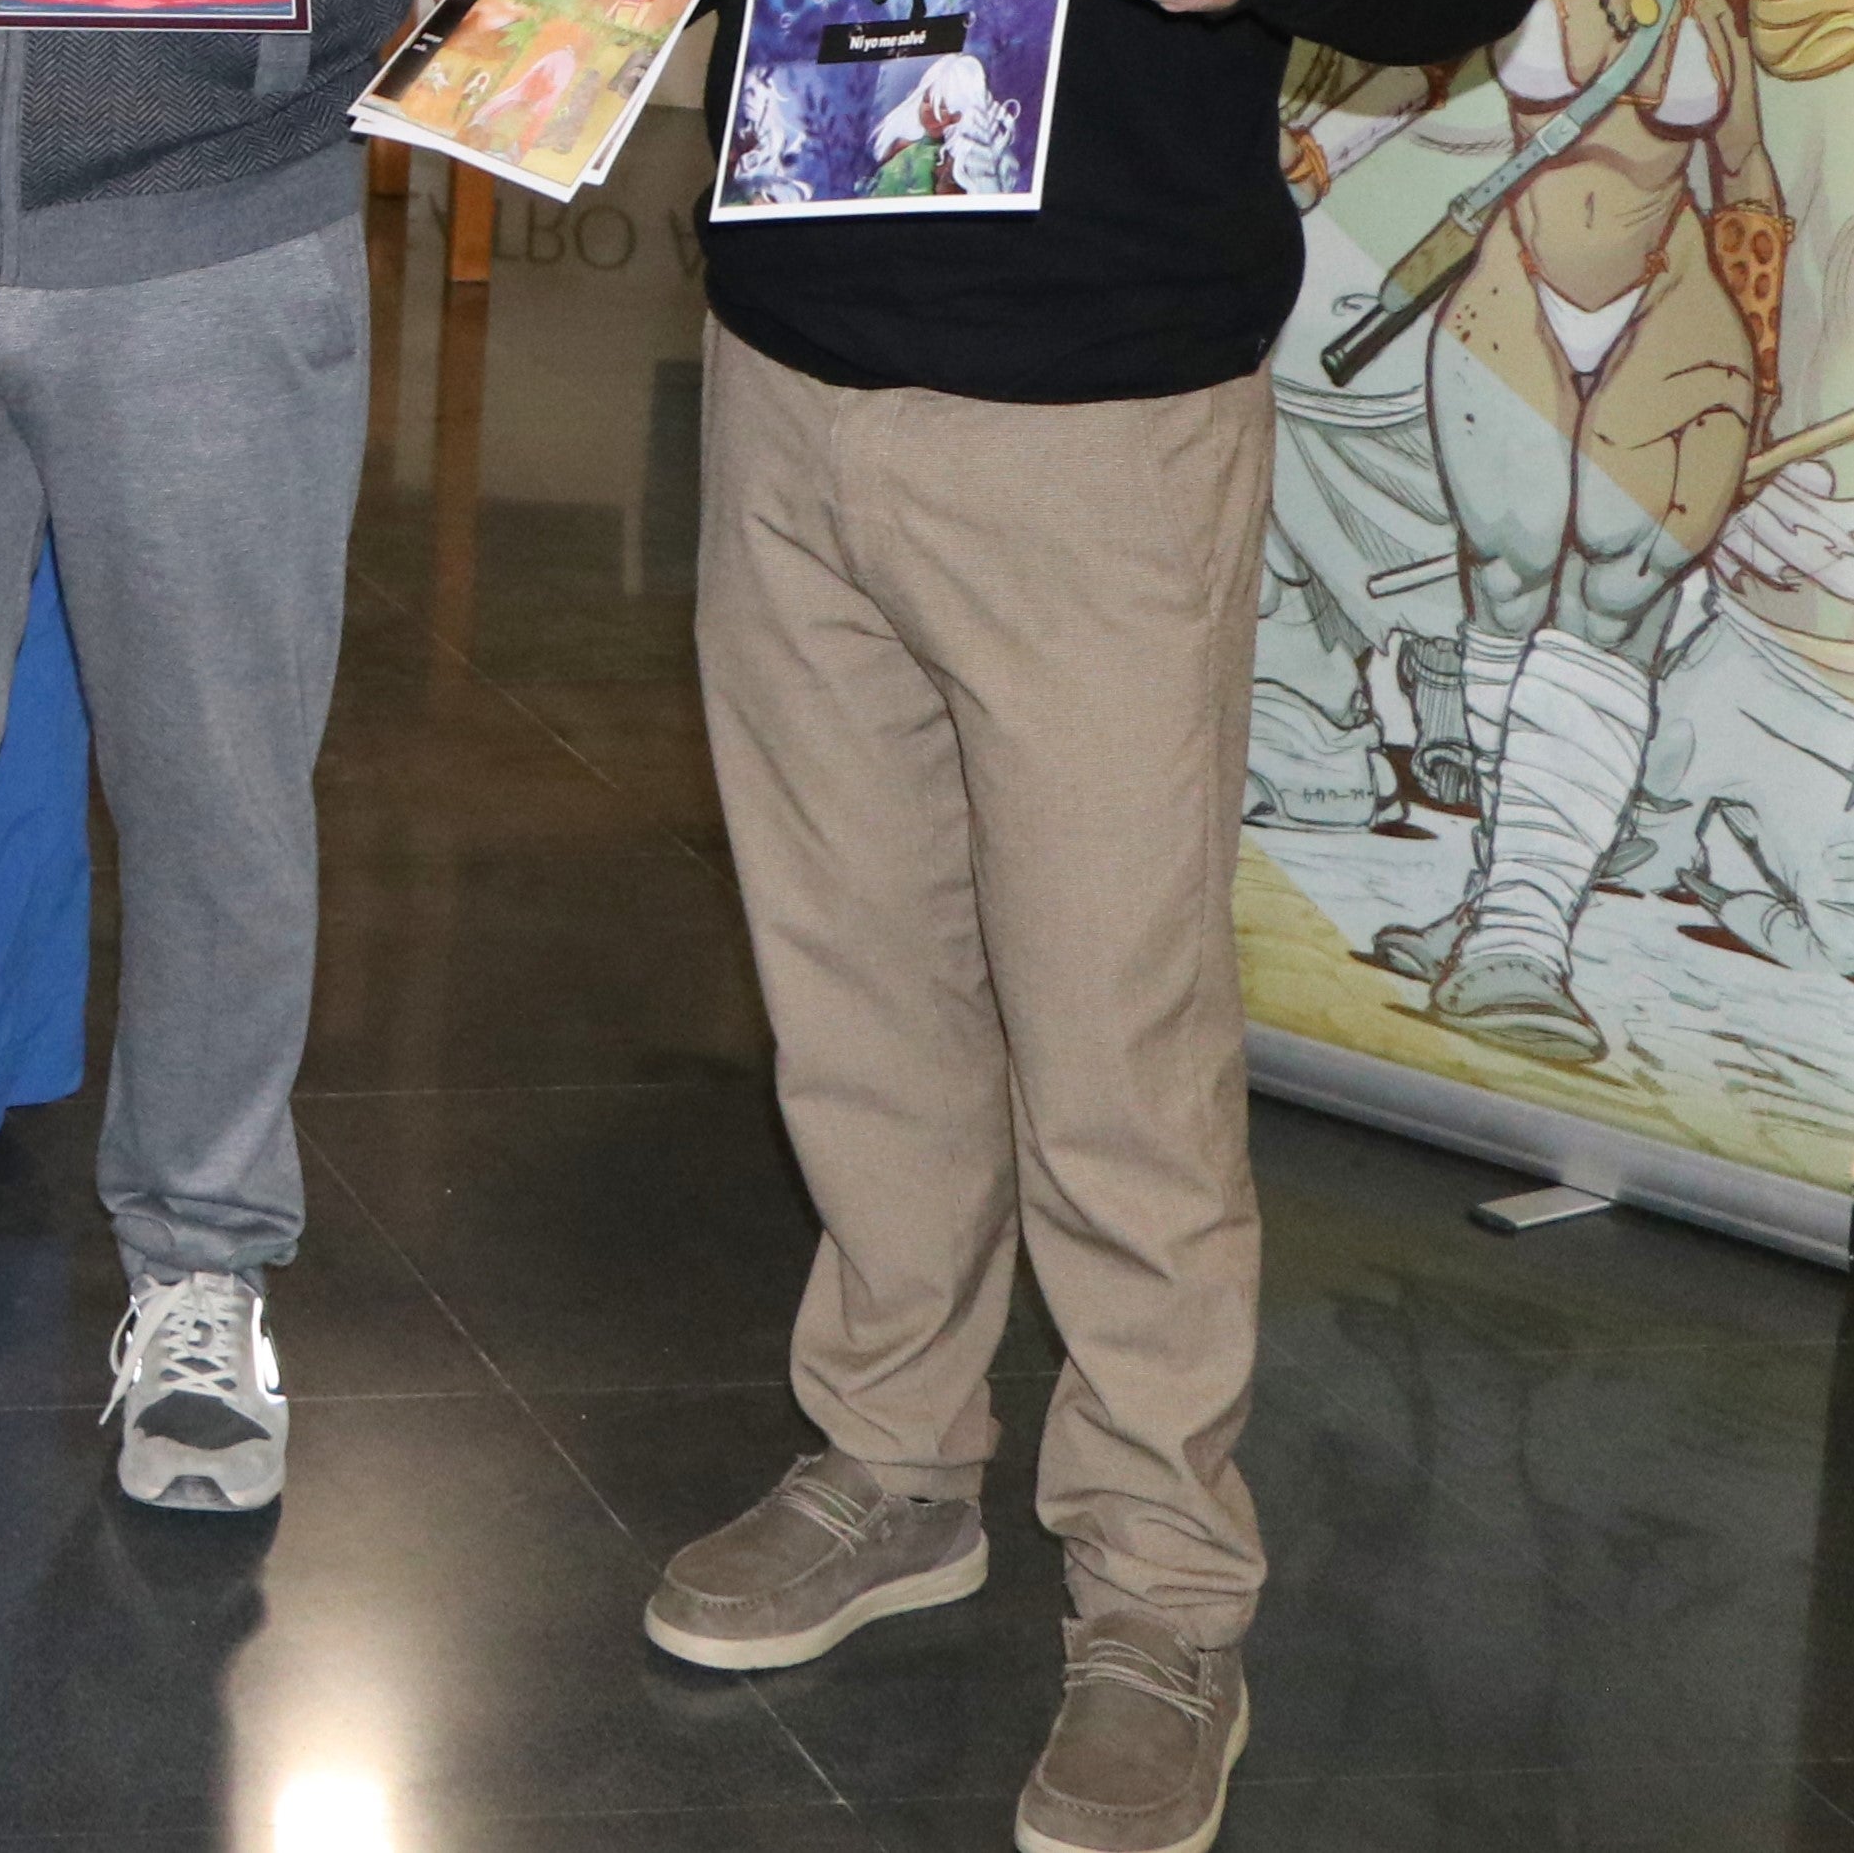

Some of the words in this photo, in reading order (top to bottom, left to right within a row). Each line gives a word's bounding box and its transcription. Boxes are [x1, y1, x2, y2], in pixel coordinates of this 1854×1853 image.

[849, 35, 864, 51] Ni
[864, 37, 877, 52] yo
[878, 35, 897, 48] me
[897, 30, 927, 46] salvé
